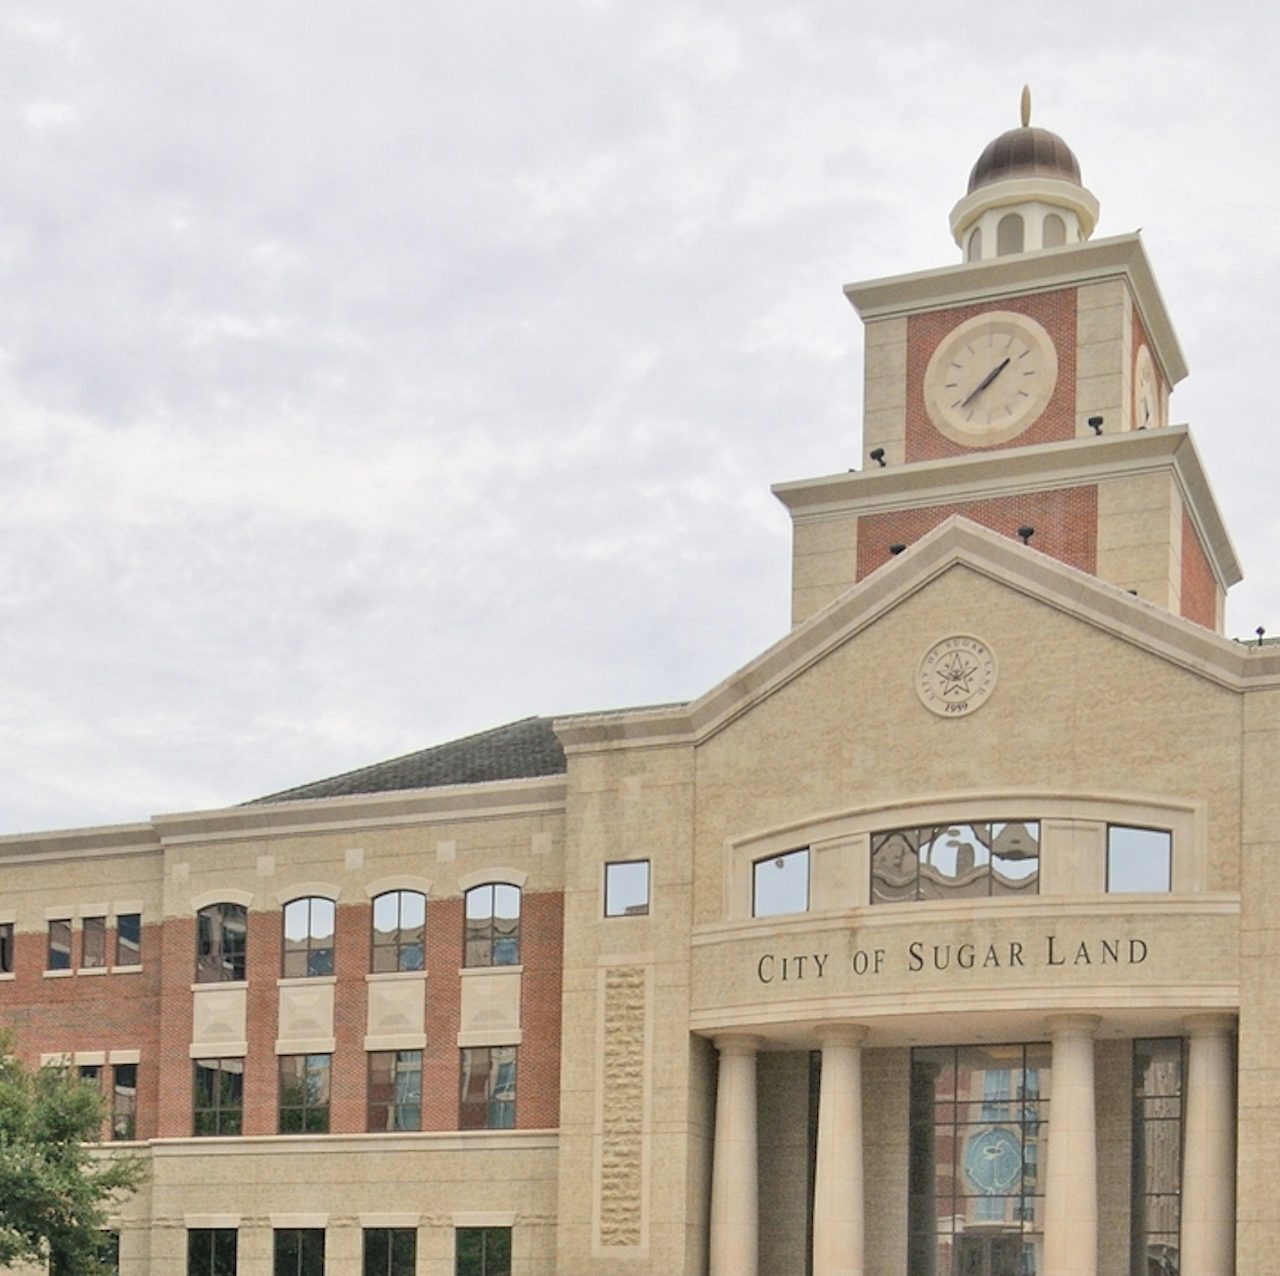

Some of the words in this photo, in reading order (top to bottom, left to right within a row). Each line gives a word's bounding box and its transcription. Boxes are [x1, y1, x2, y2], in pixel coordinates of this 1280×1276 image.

[757, 953, 829, 984] CITY
[852, 949, 886, 975] OF
[908, 941, 1024, 972] SUGAR
[1046, 935, 1149, 966] LAND
